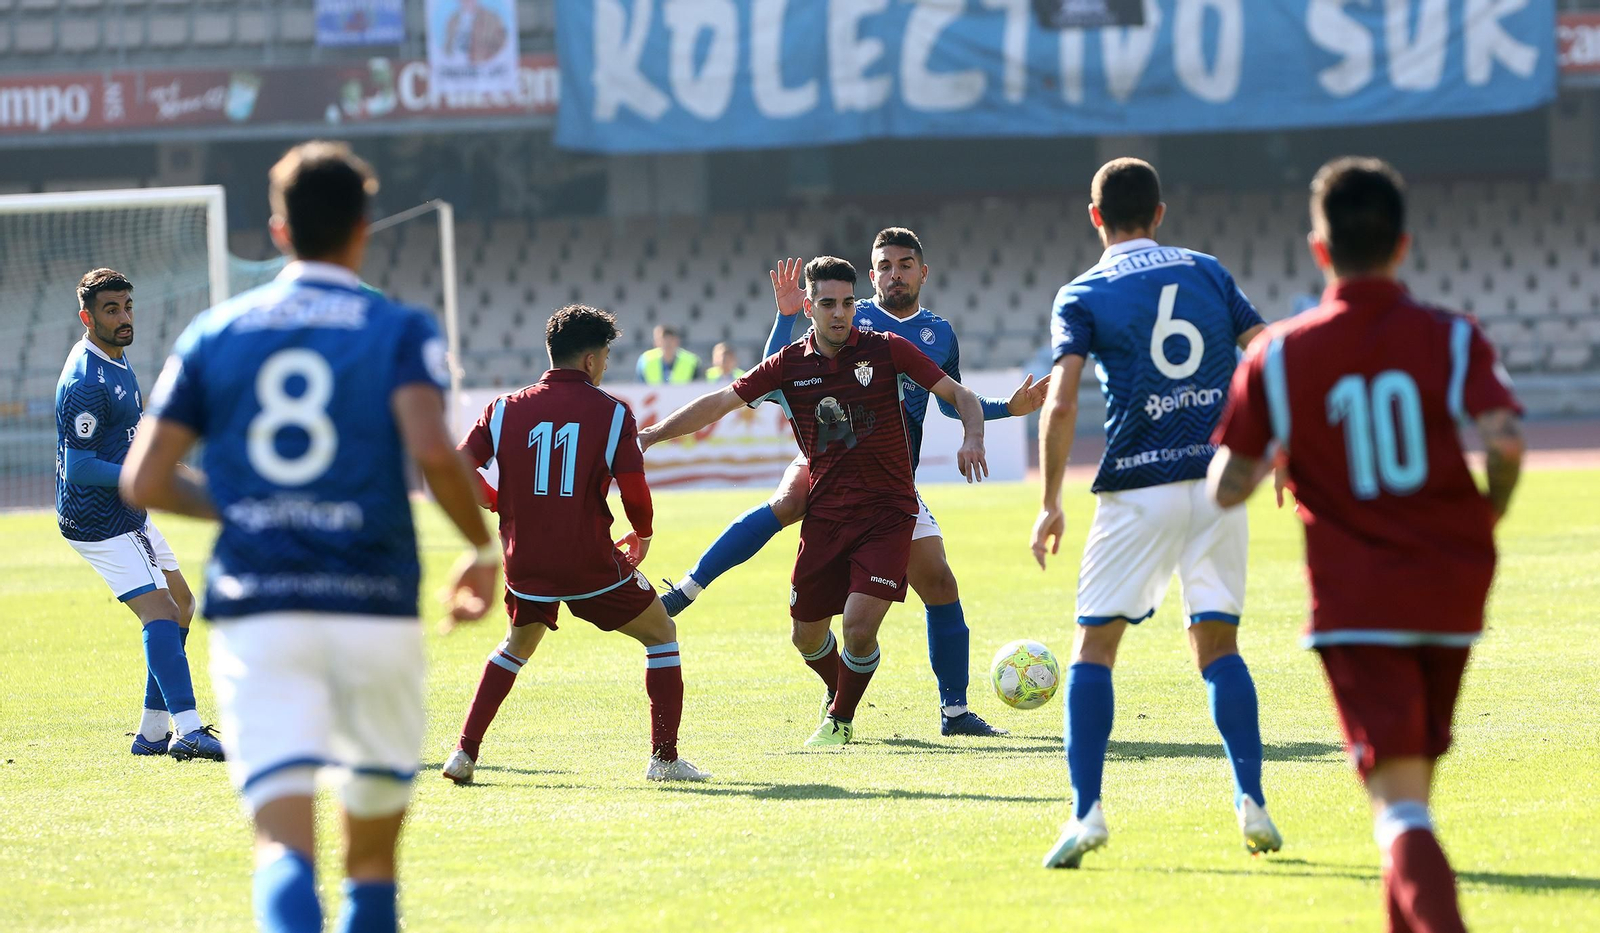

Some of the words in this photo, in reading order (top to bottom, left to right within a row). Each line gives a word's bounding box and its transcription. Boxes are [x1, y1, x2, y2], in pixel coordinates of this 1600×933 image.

[592, 0, 1244, 121] KOLECTIVO
[1150, 282, 1205, 380] 6
[247, 347, 339, 487] 8
[793, 376, 823, 387] macron
[527, 421, 580, 497] 11
[1115, 450, 1160, 470] XEREZ
[1160, 443, 1220, 461] DEPORTIV
[1325, 369, 1428, 500] 10
[870, 575, 898, 589] macron
